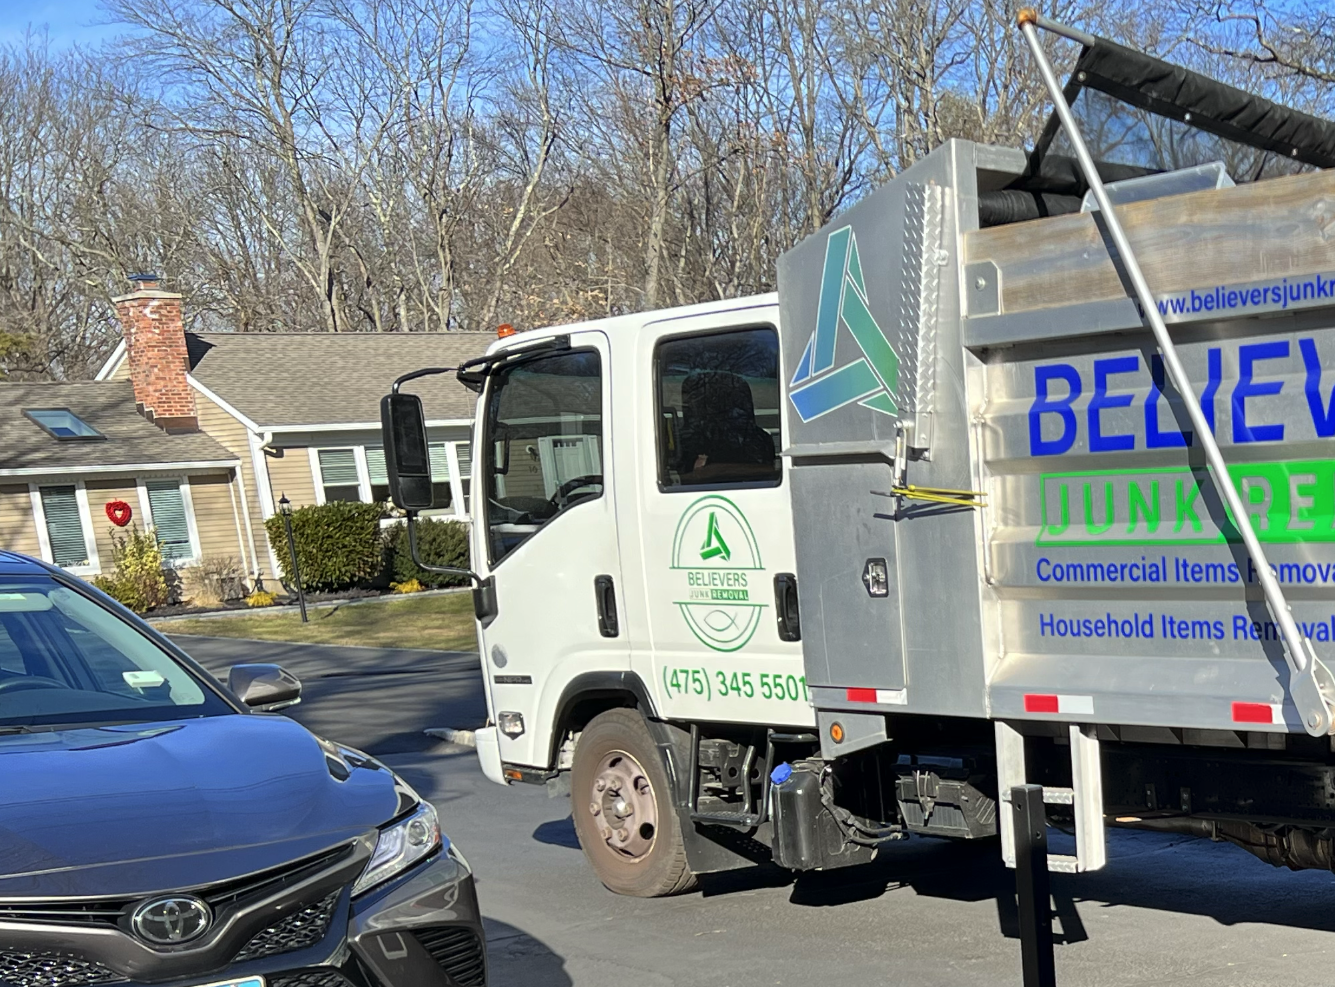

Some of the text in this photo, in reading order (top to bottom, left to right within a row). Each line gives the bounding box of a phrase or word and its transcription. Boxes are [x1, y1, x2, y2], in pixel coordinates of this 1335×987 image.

[1047, 479, 1205, 536] JUNK
[687, 571, 749, 587] BELIEVERS
[1035, 555, 1168, 583] Commercial
[1174, 556, 1240, 583] Items
[690, 589, 749, 600] JUNK REMOVAL
[1039, 612, 1154, 640] Household
[1161, 613, 1226, 641] Items
[662, 666, 808, 702] (475) 345 5501
